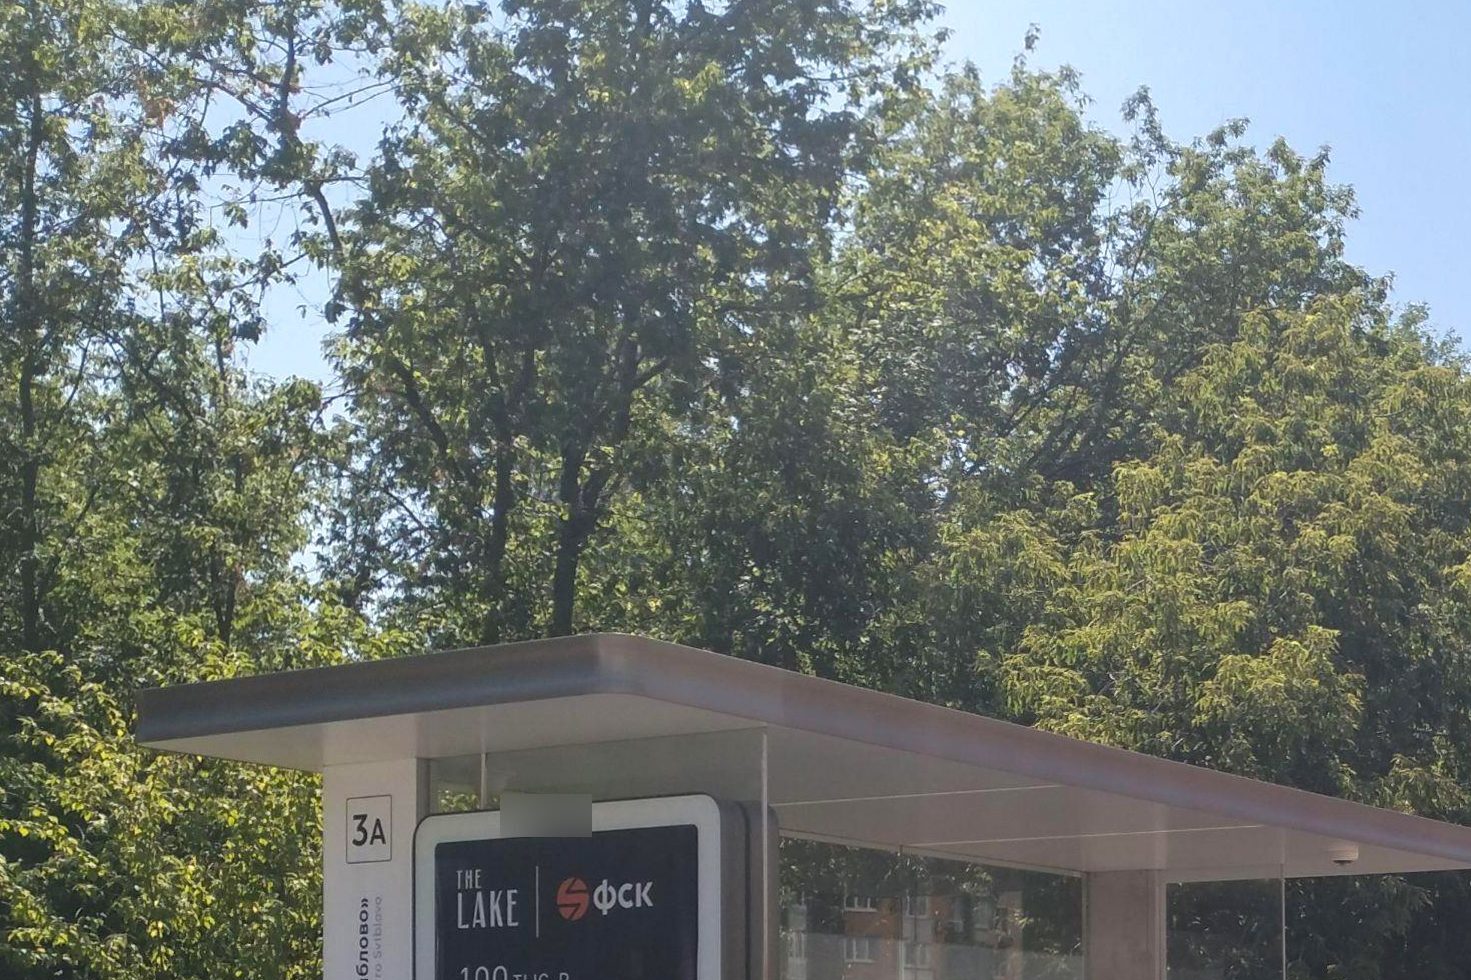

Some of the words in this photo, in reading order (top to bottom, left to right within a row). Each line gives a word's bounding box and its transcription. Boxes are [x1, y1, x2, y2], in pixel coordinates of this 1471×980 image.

[352, 814, 386, 847] 3А
[456, 869, 482, 889] THE
[373, 896, 382, 959] Sviblovo
[457, 890, 519, 929] LAKE
